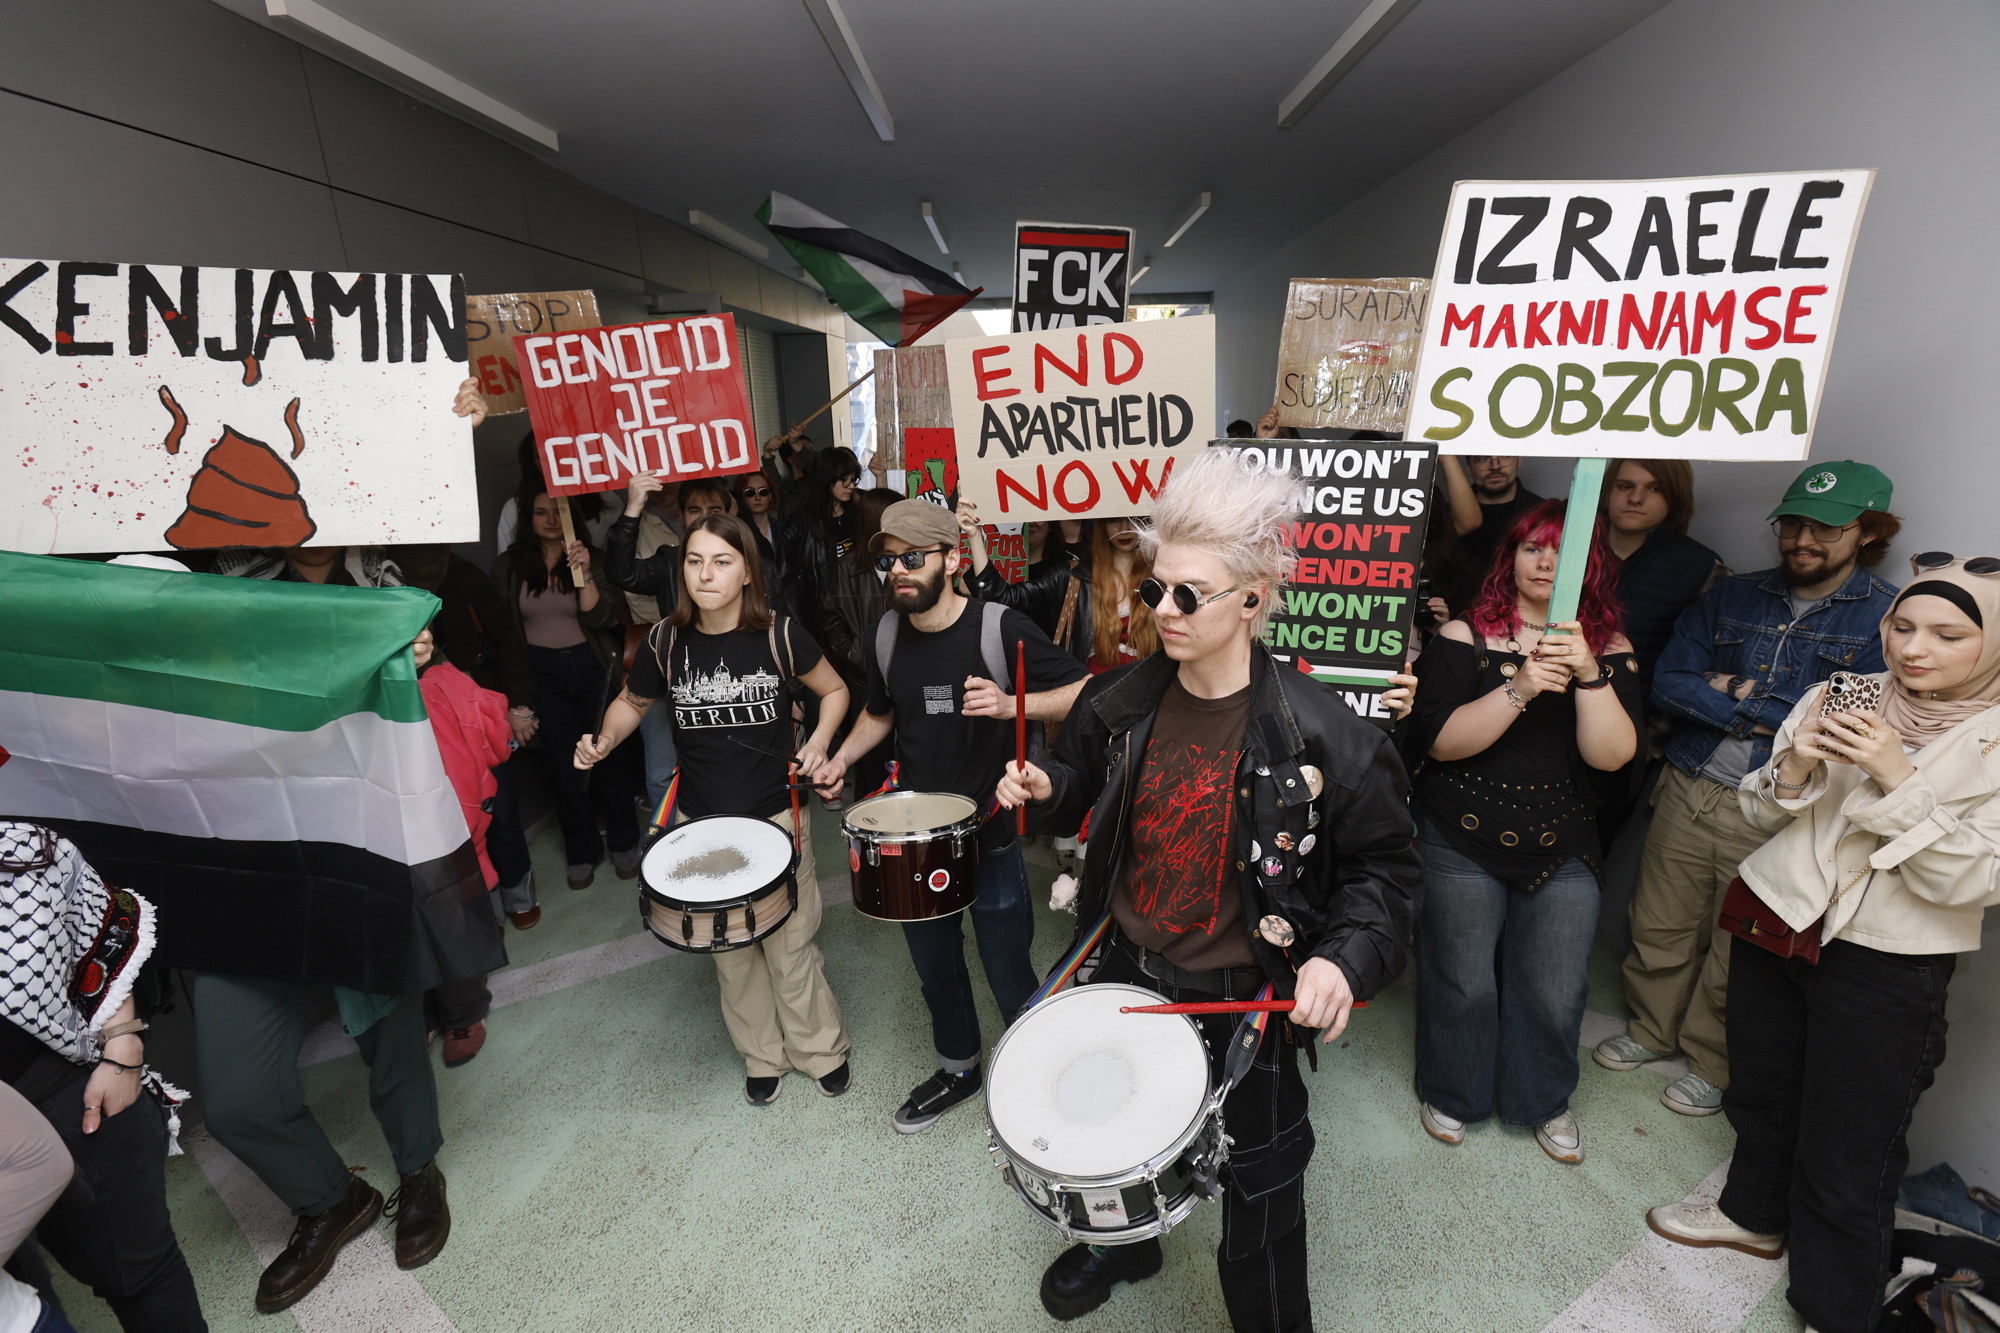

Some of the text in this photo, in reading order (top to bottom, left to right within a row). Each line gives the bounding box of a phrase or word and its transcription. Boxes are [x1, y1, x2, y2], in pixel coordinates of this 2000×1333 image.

[1454, 180, 1844, 284] IZRAELE
[1018, 249, 1124, 308] FCK
[1440, 285, 1828, 356] MAKNI NAM SE
[525, 317, 731, 389] GENOCID
[972, 332, 1144, 401] END
[610, 379, 677, 430] JE
[977, 392, 1194, 458] APARTHEID
[1423, 358, 1808, 440] S OBZORA
[544, 419, 750, 486] GENOCID
[1299, 449, 1430, 480] WON'T
[996, 456, 1175, 513] NOW
[1373, 488, 1425, 517] US
[987, 533, 1027, 559] FOR
[1286, 590, 1406, 622] WON'T
[1355, 629, 1403, 657] US
[675, 702, 777, 727] BERLIN
